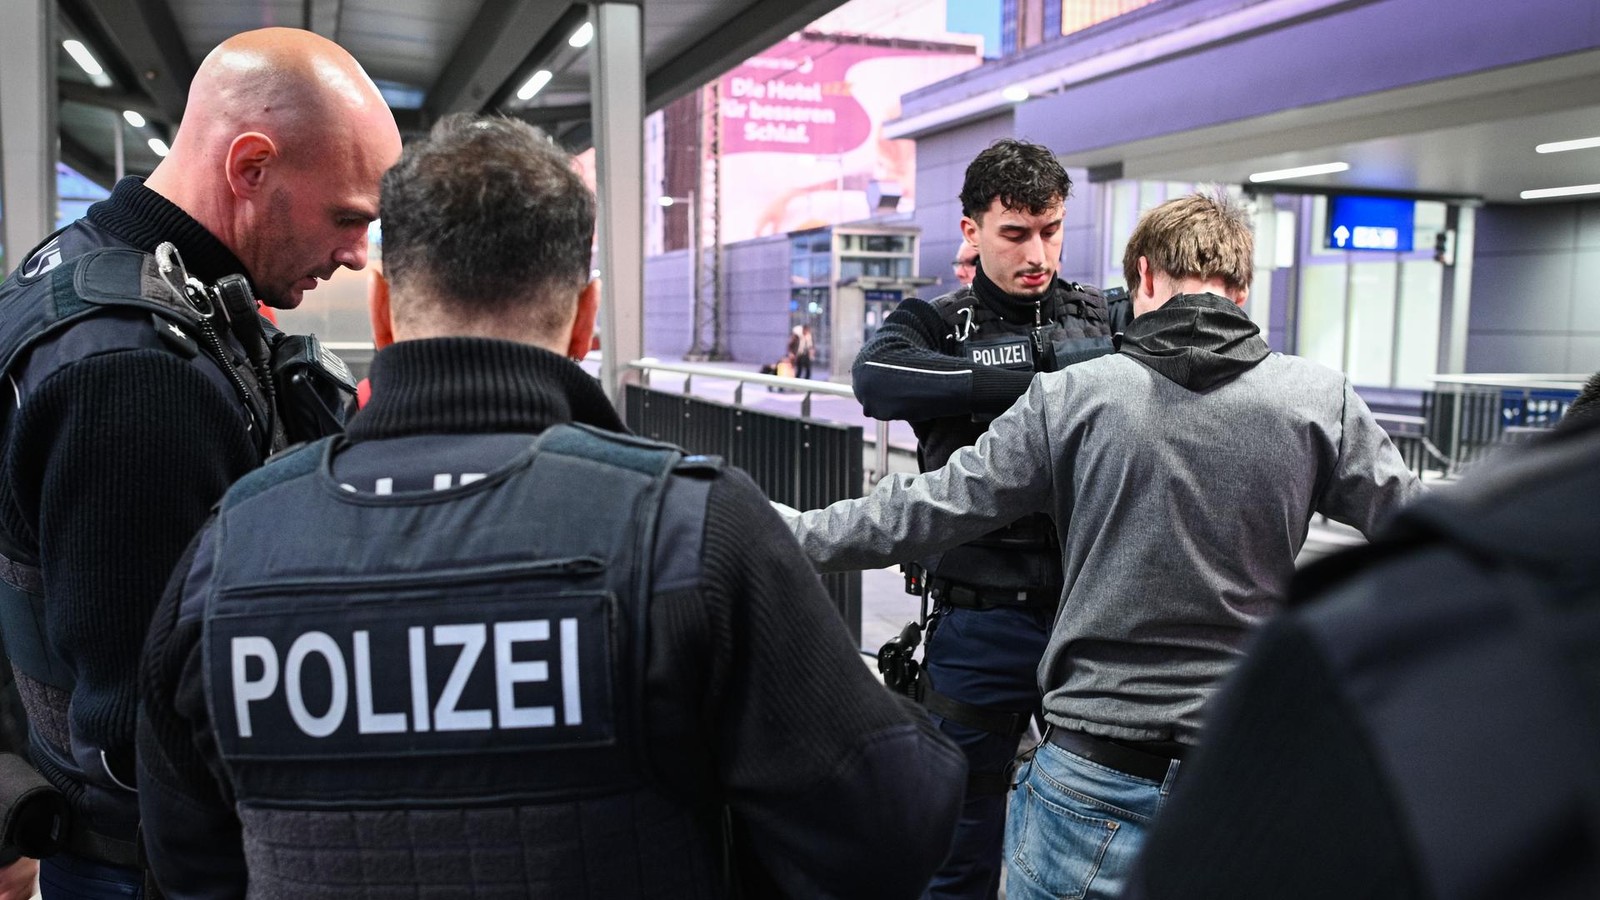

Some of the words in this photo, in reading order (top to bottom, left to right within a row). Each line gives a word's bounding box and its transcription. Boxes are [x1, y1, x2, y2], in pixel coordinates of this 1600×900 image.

[731, 77, 765, 98] Die
[749, 100, 836, 124] besseren
[744, 121, 810, 143] Schlaf.
[972, 344, 1027, 366] POLIZEI
[231, 618, 582, 738] POLIZEI
